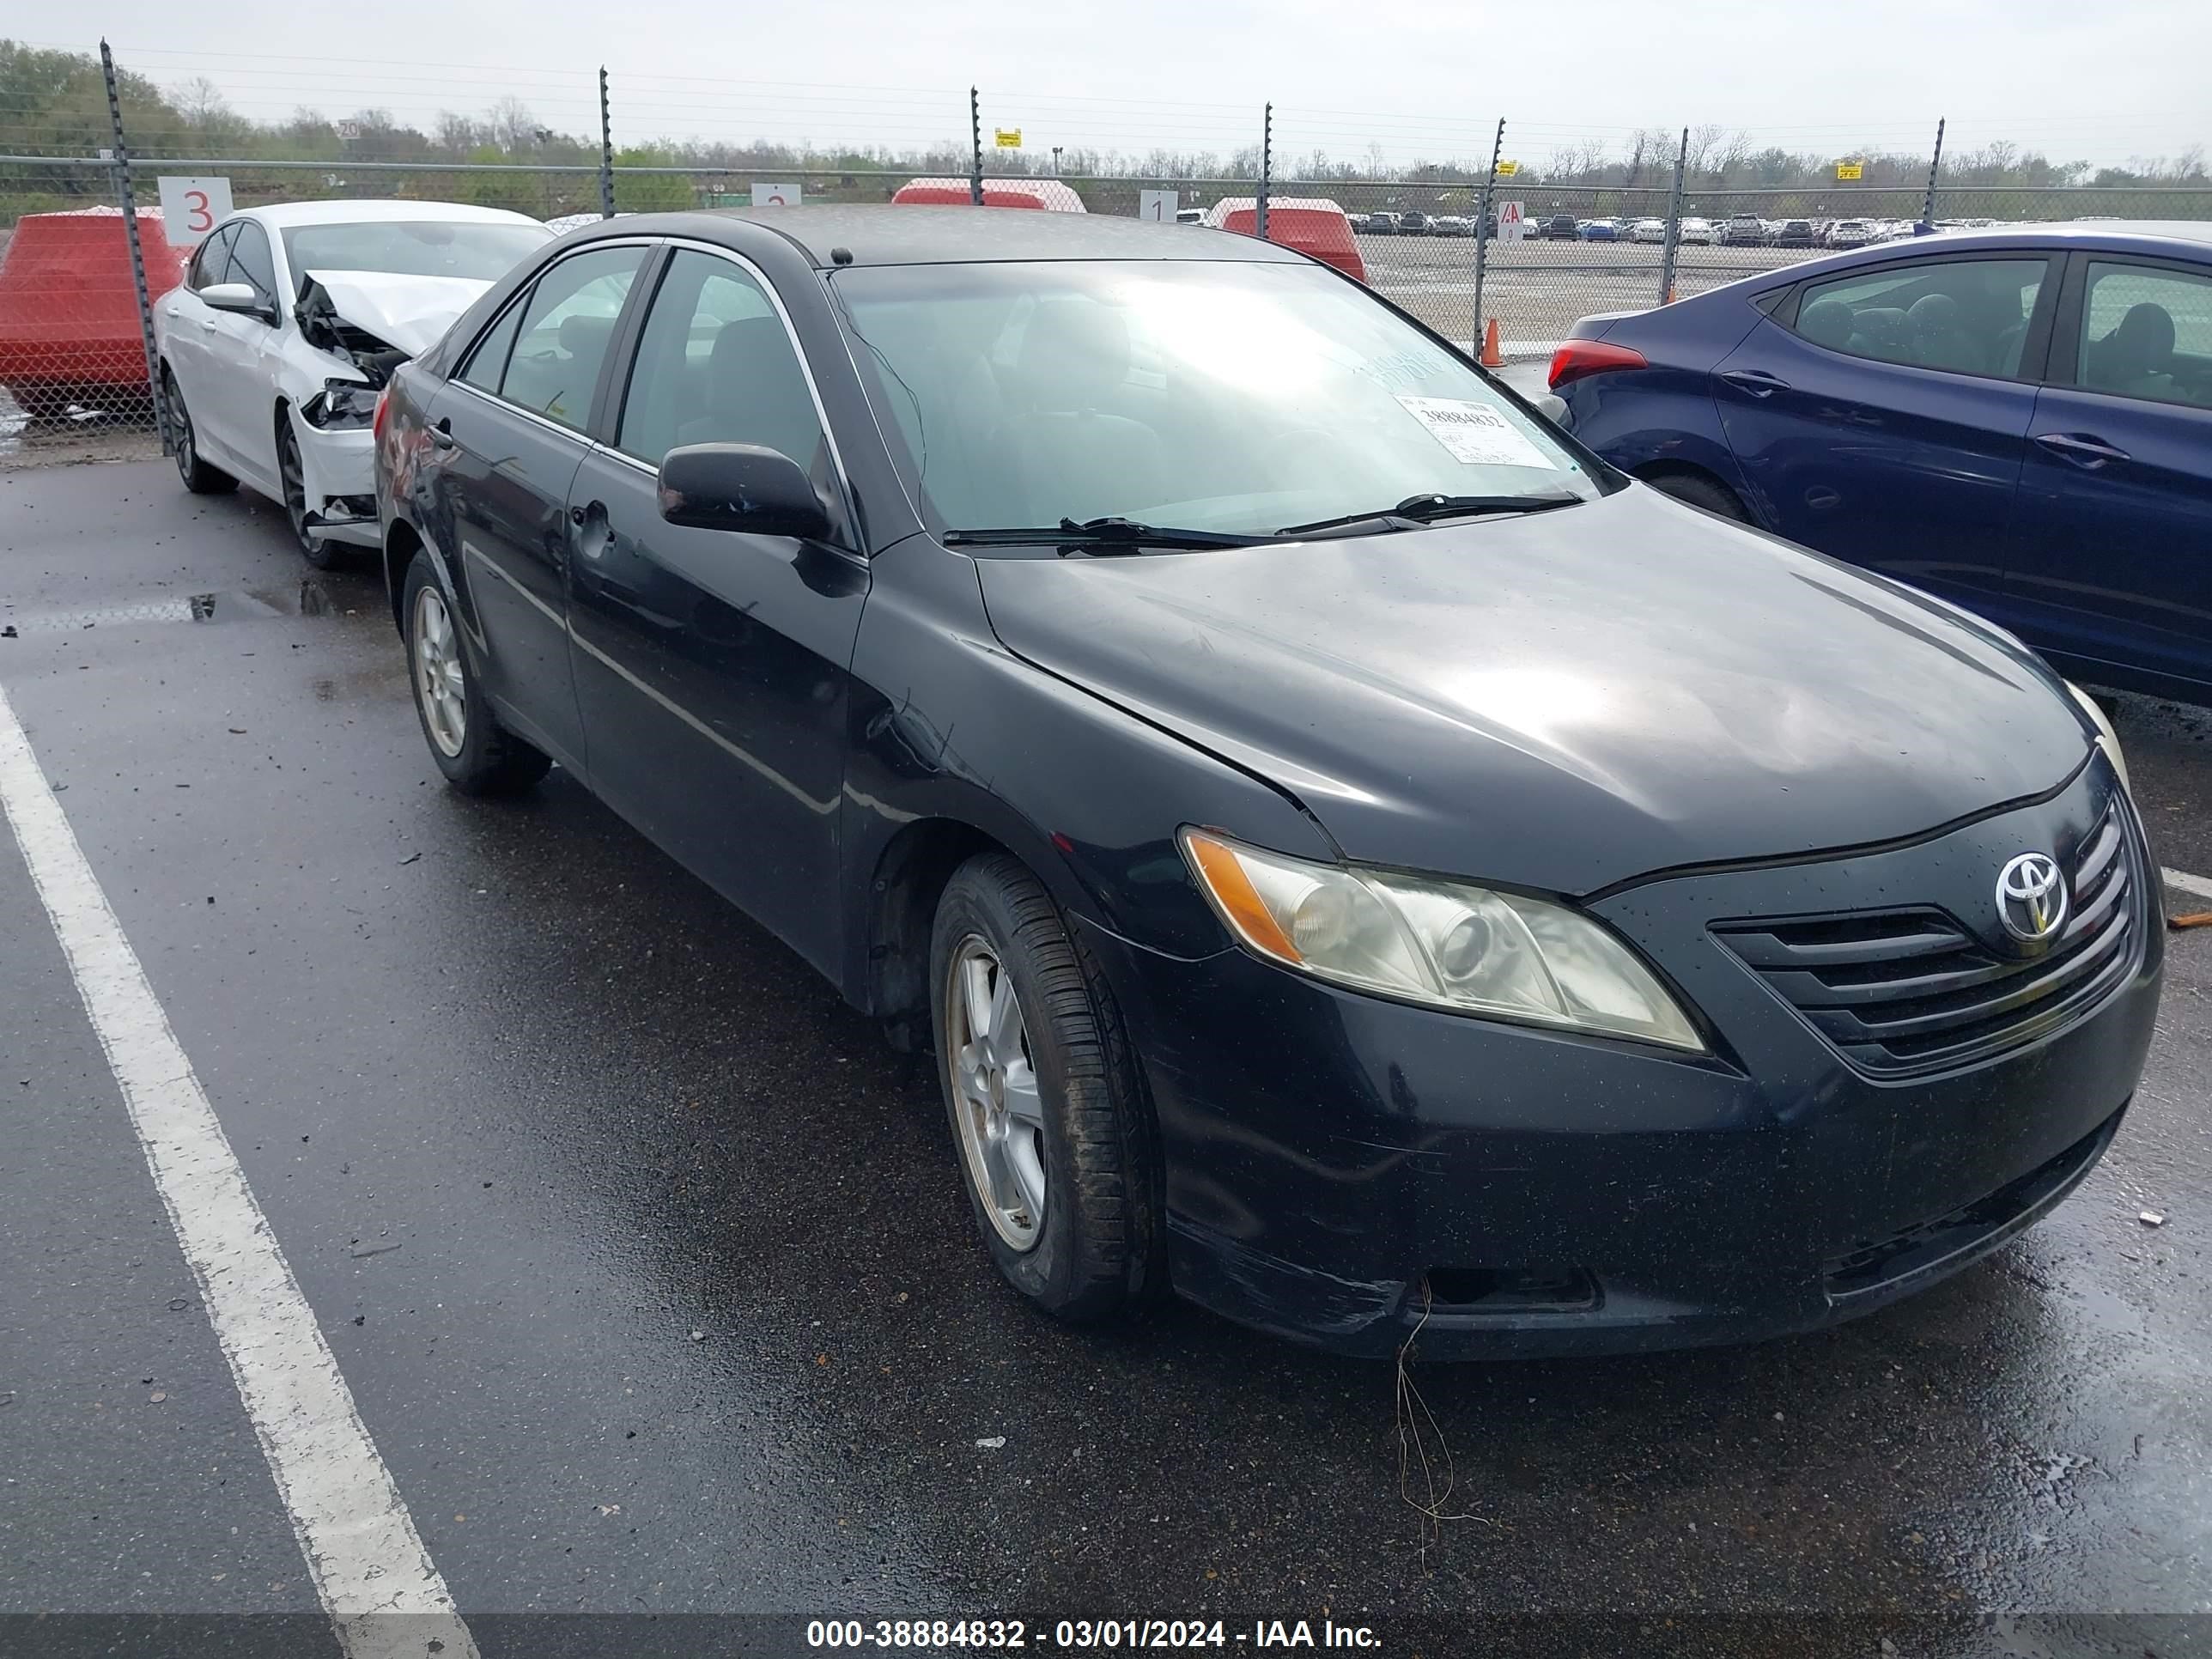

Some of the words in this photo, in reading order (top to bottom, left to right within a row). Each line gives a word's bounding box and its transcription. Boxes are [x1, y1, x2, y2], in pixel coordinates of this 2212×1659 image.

[185, 191, 213, 232] 3
[1152, 199, 1162, 222] 1
[1420, 410, 1504, 428] 38884832
